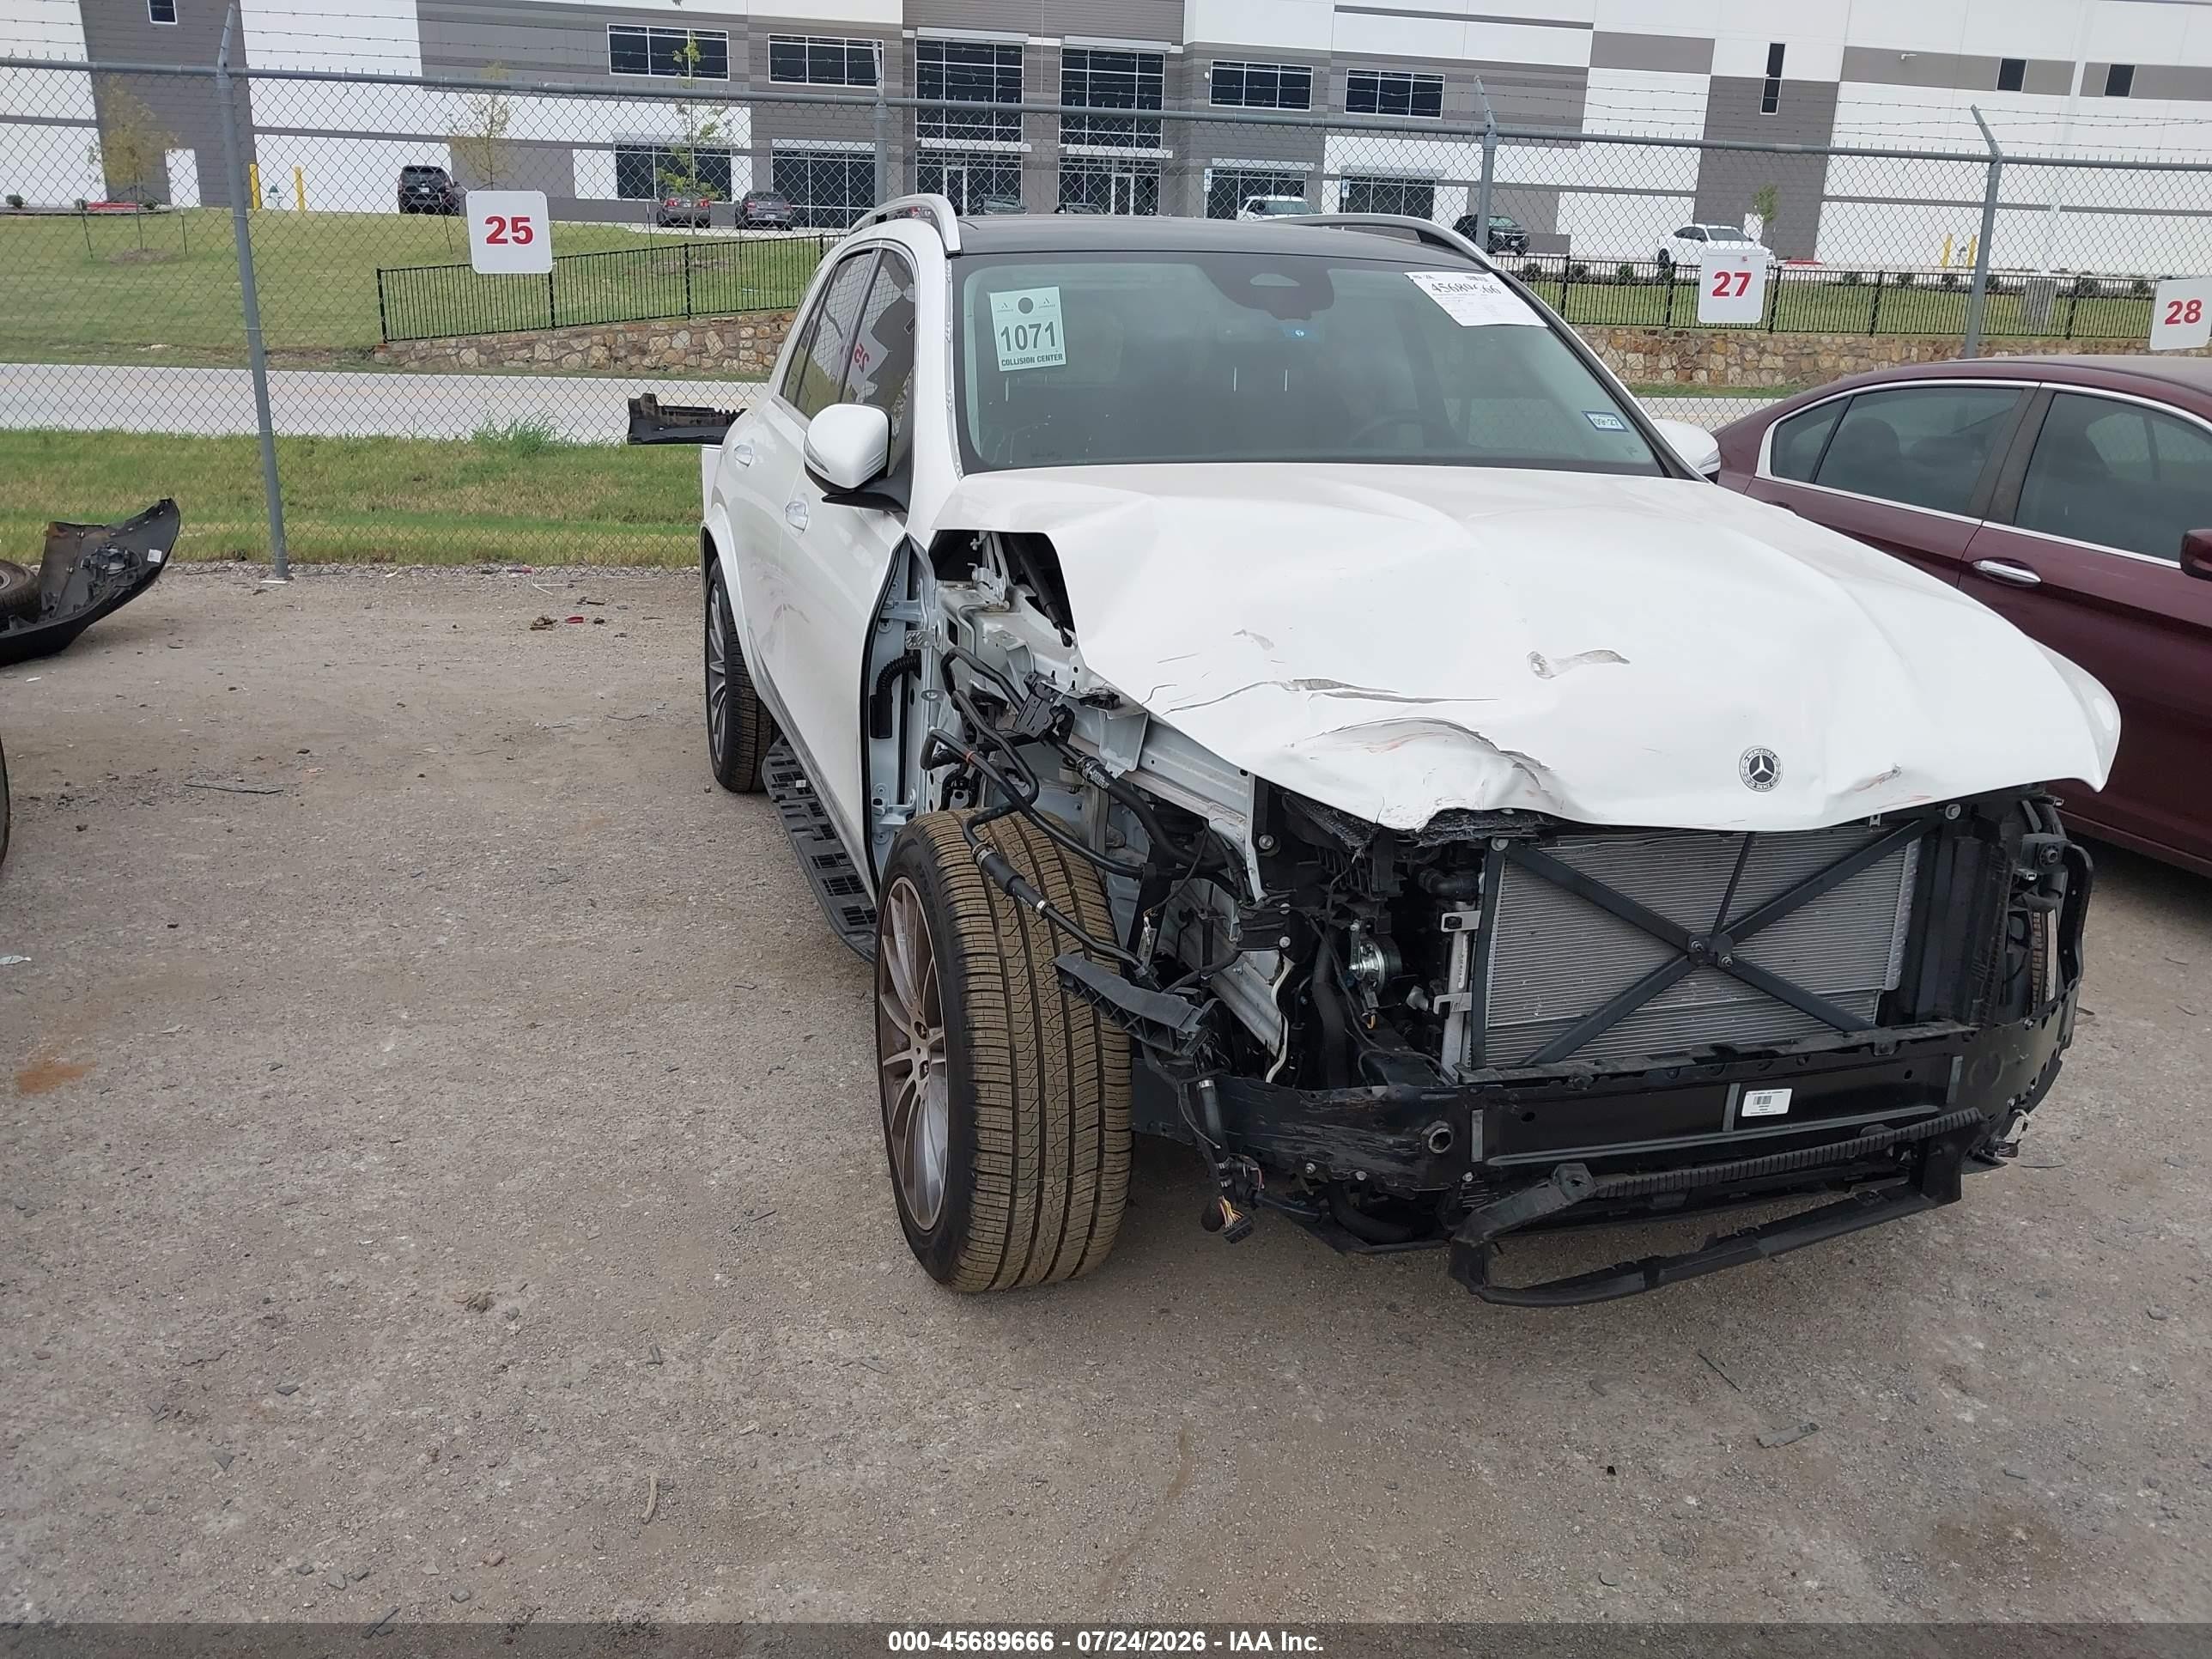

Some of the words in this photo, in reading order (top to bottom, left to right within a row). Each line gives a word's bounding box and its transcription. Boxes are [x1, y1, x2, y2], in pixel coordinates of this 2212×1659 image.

[484, 216, 533, 245] 25
[1712, 271, 1752, 297] 27
[2165, 299, 2203, 325] 28
[1000, 321, 1055, 352] 1071
[1001, 356, 1036, 367] COLLISION
[1036, 353, 1064, 363] CENTER
